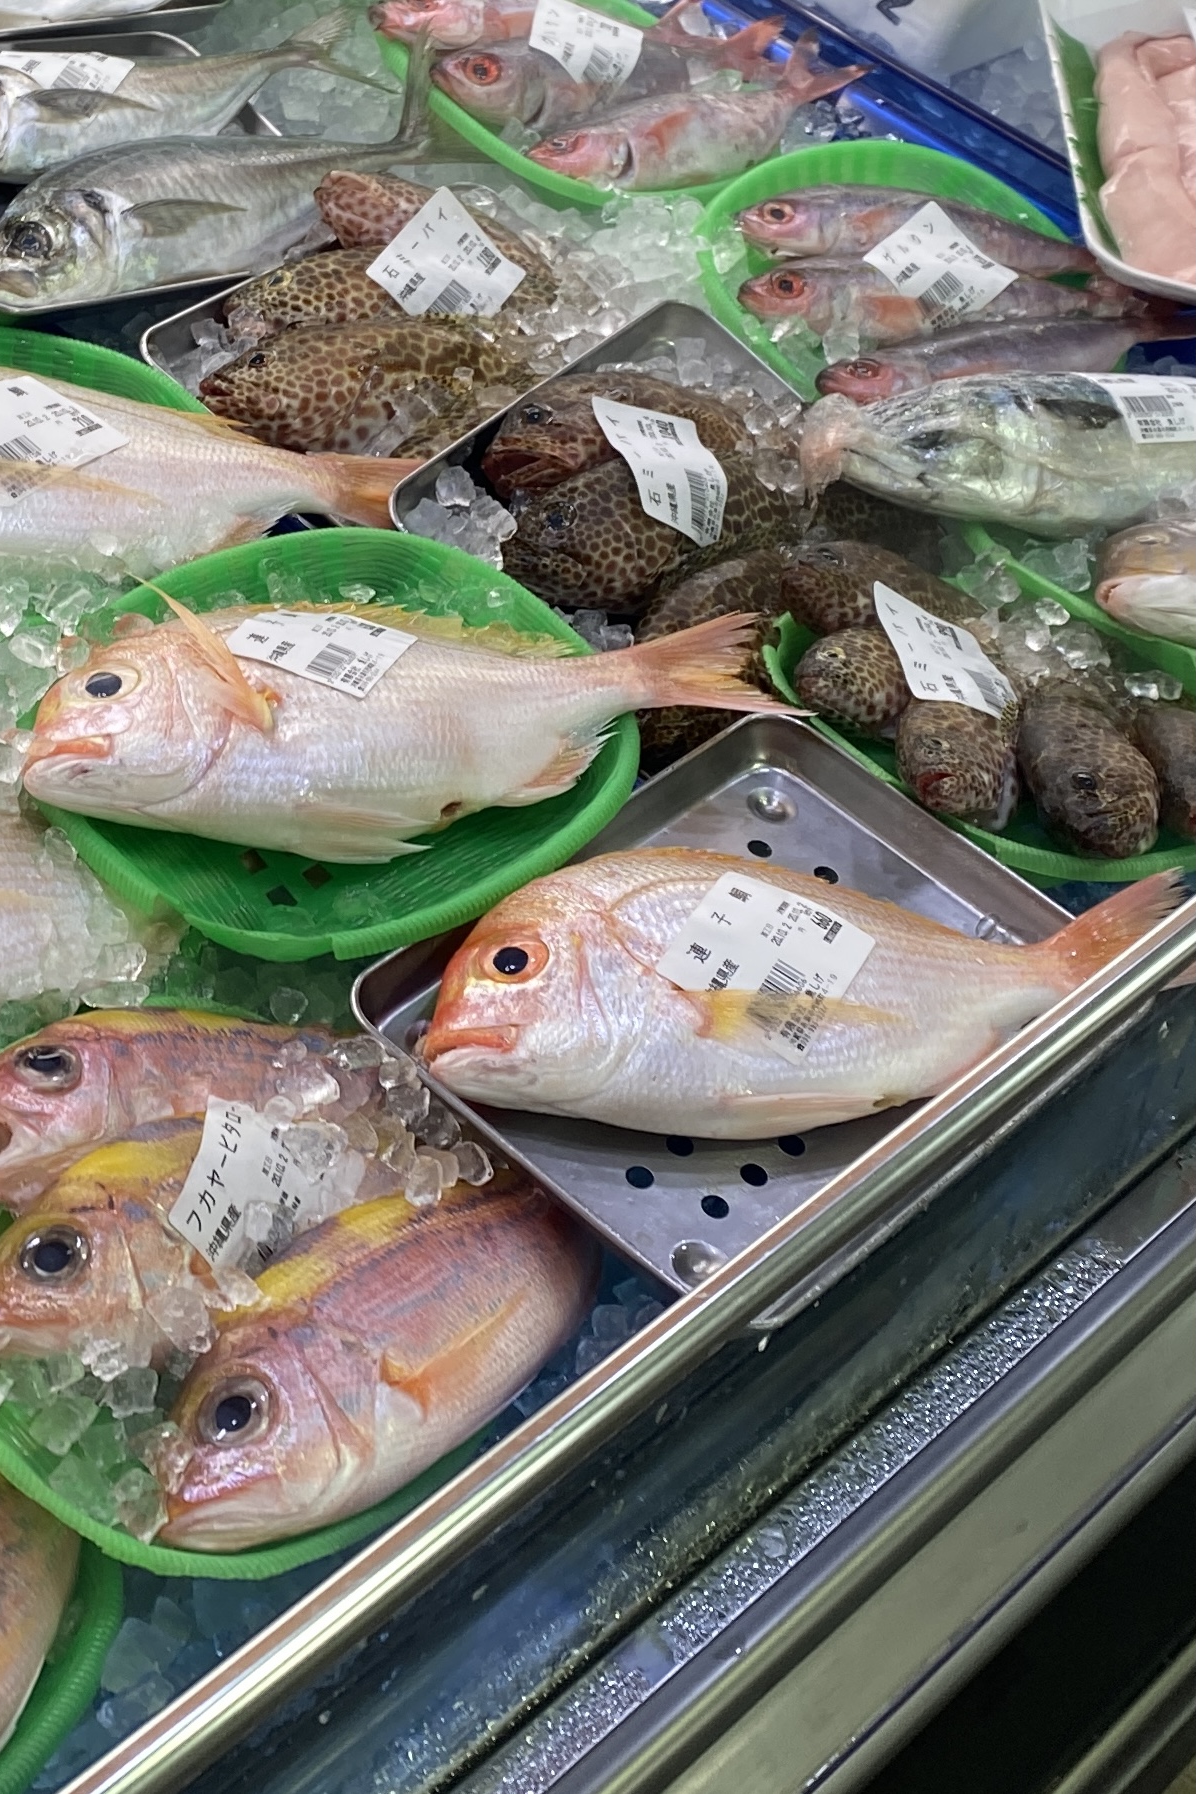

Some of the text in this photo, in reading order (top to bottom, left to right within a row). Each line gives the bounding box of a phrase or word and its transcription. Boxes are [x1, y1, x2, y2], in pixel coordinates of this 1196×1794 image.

[381, 206, 447, 281] 石ミーバイ
[605, 414, 662, 506] 石ミーバイ
[885, 602, 938, 692] 石ミーバイ
[686, 885, 752, 963] 連子鯛
[810, 910, 834, 930] 660
[205, 1202, 242, 1260] 沖縄県産
